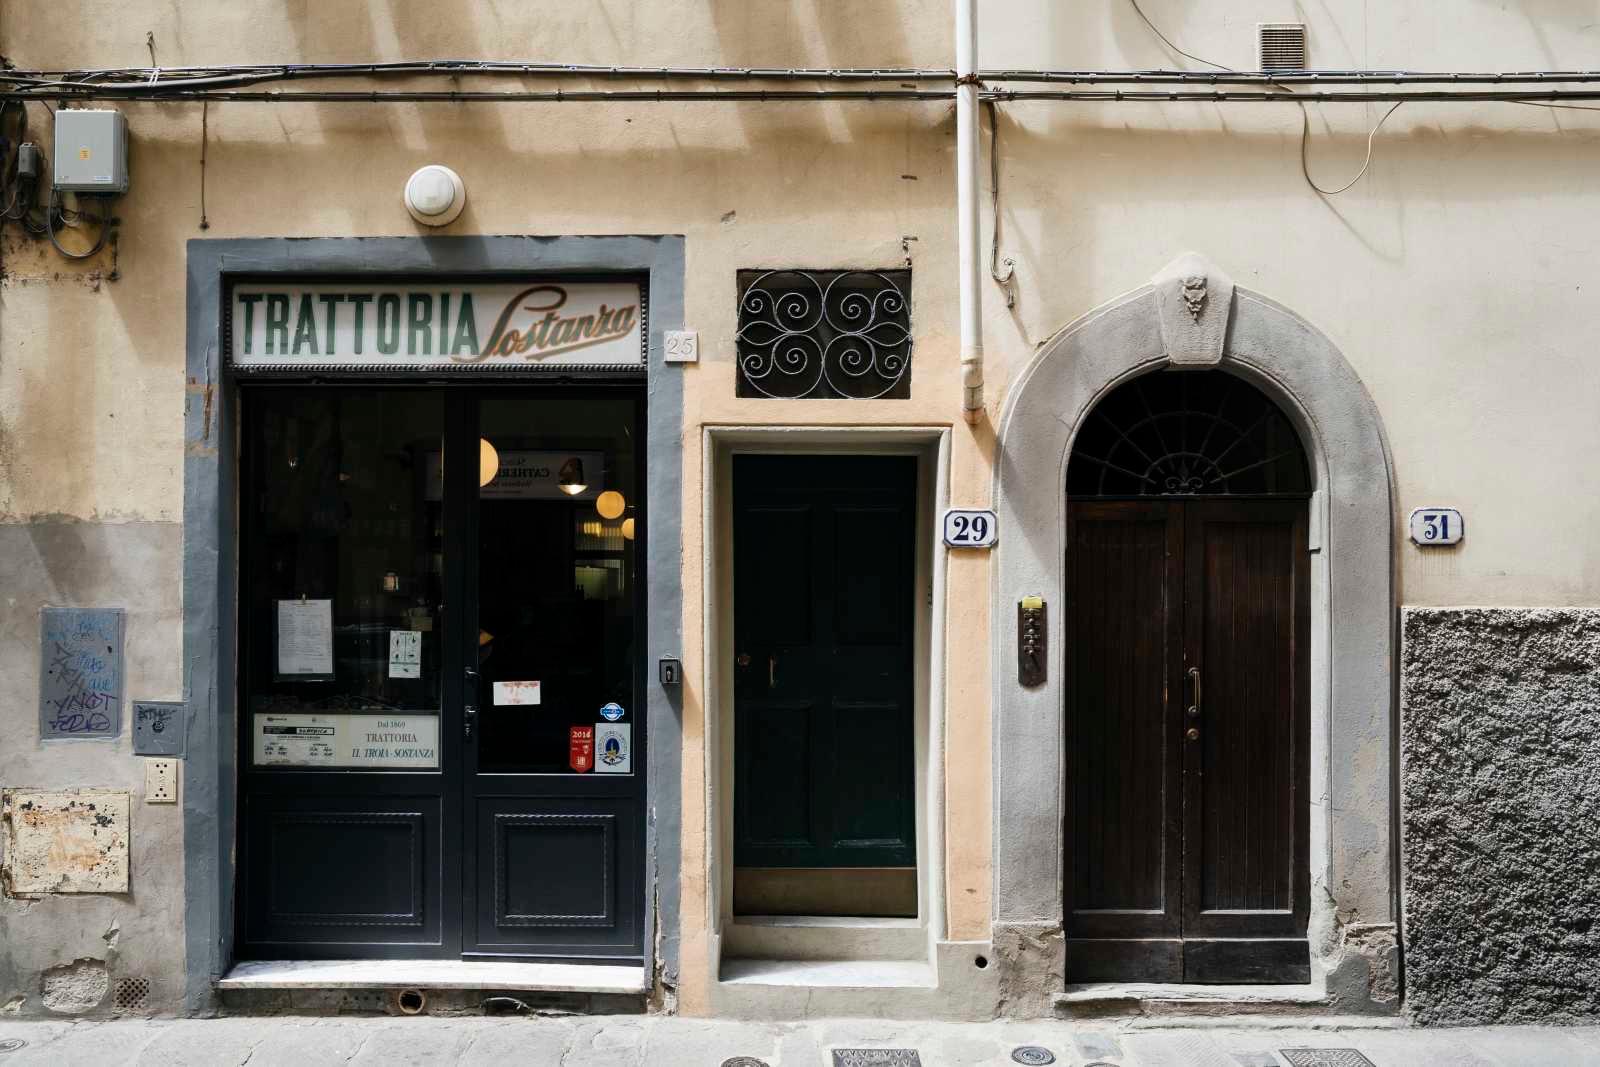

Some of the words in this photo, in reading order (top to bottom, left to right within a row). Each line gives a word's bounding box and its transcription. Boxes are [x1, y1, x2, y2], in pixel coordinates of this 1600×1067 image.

[238, 291, 481, 356] TRATTORIA
[451, 285, 637, 364] Sostanza
[666, 337, 693, 355] 25
[952, 515, 988, 542] 29
[1423, 514, 1449, 540] 31
[377, 720, 389, 728] Dal
[366, 733, 417, 743] TRATTORIA
[351, 748, 361, 758] IL
